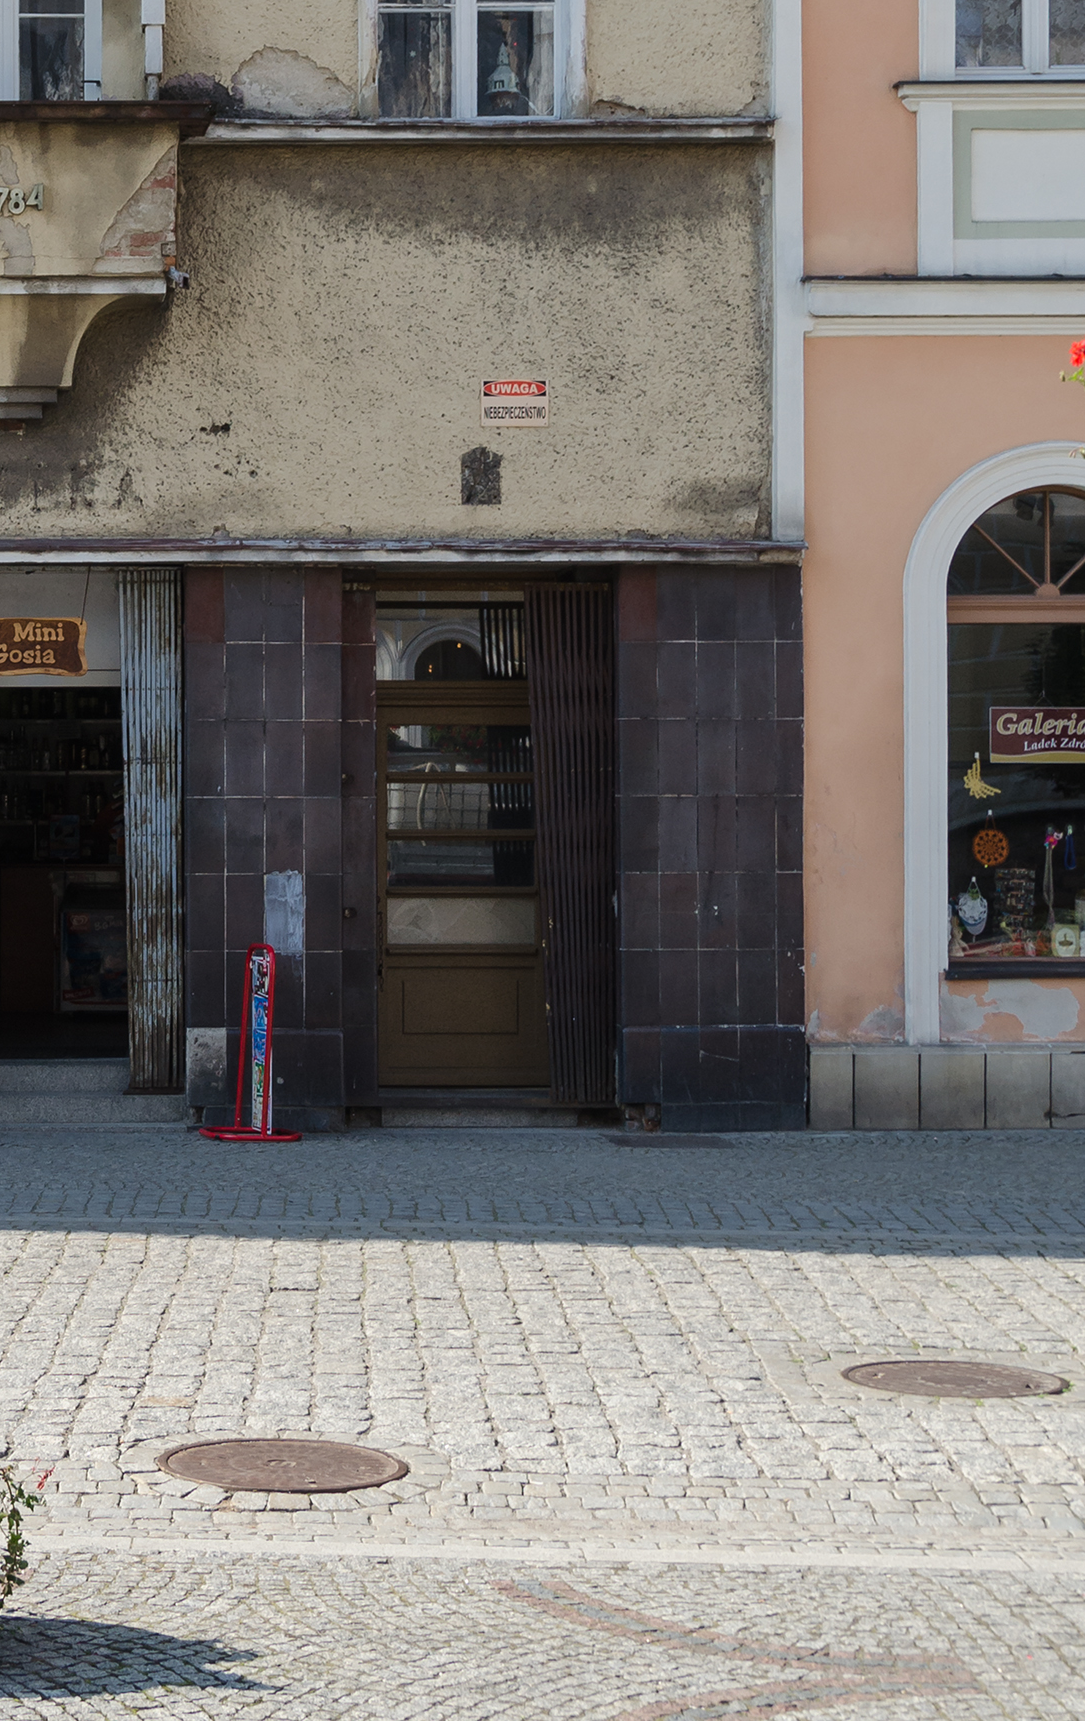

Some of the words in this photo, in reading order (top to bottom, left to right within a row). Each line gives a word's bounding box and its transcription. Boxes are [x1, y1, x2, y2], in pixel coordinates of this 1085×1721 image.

[491, 383, 539, 395] UWAGA
[13, 621, 65, 642] Mini
[996, 712, 1085, 736] Galeria
